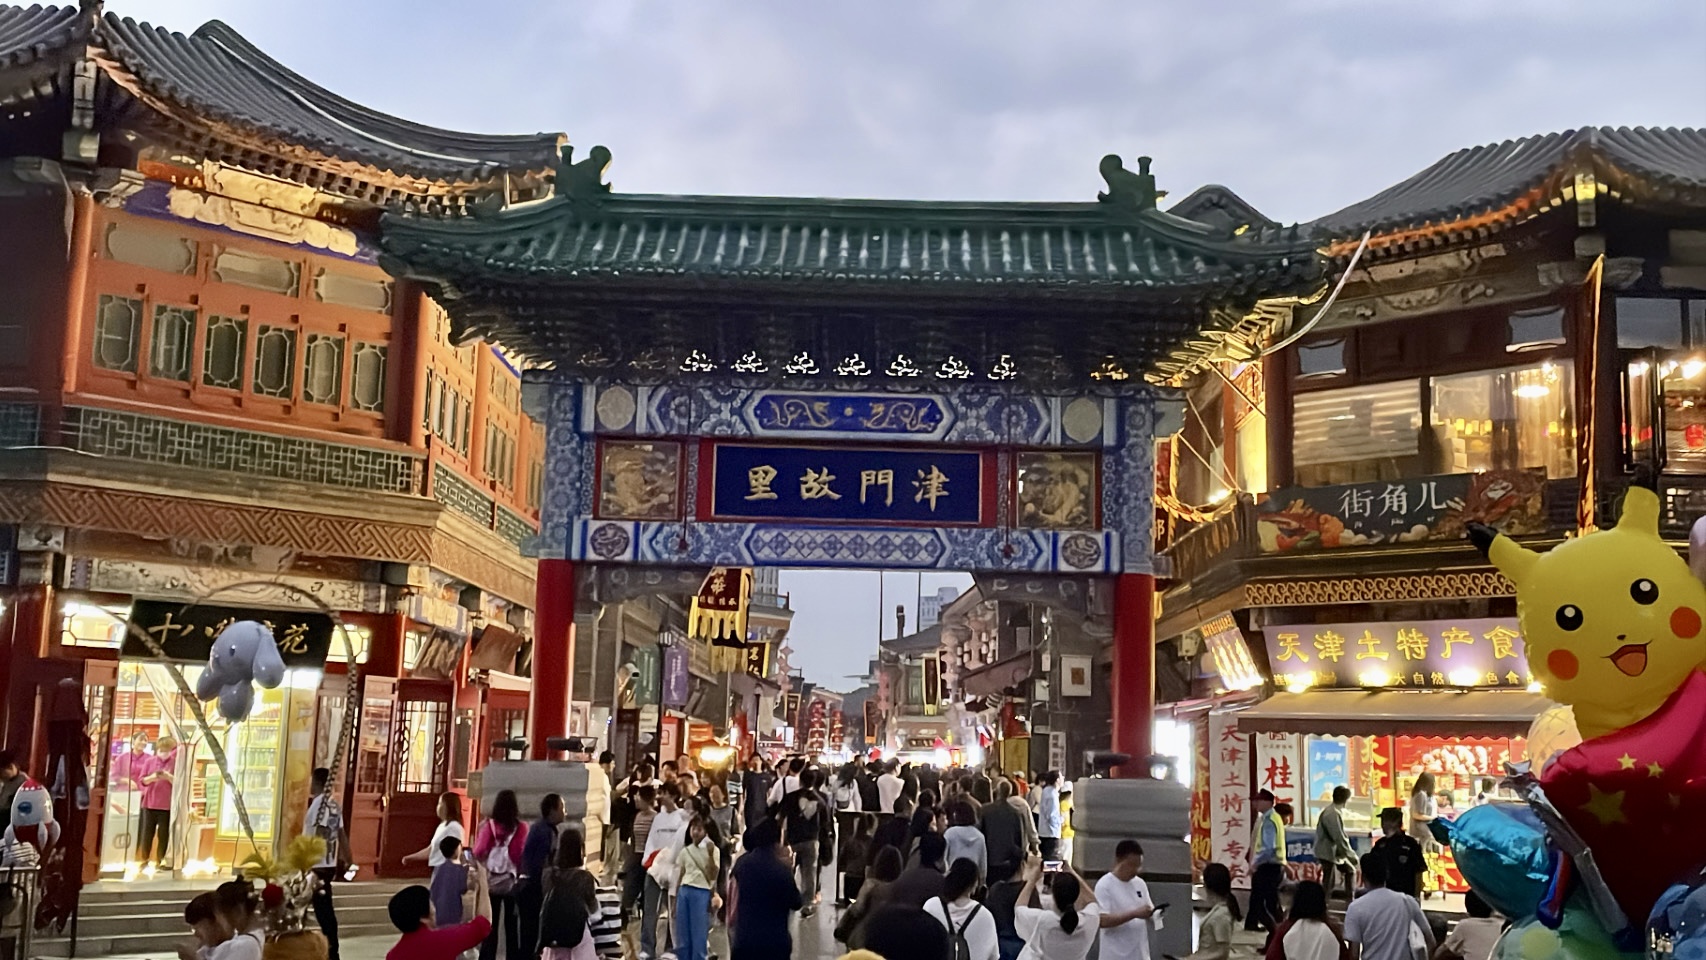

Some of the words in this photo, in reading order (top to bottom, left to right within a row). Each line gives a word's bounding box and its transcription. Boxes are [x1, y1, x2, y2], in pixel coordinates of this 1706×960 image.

[1338, 481, 1447, 518] 街角儿
[148, 612, 309, 654] 十八花
[1276, 625, 1520, 663] 天津土特产食
